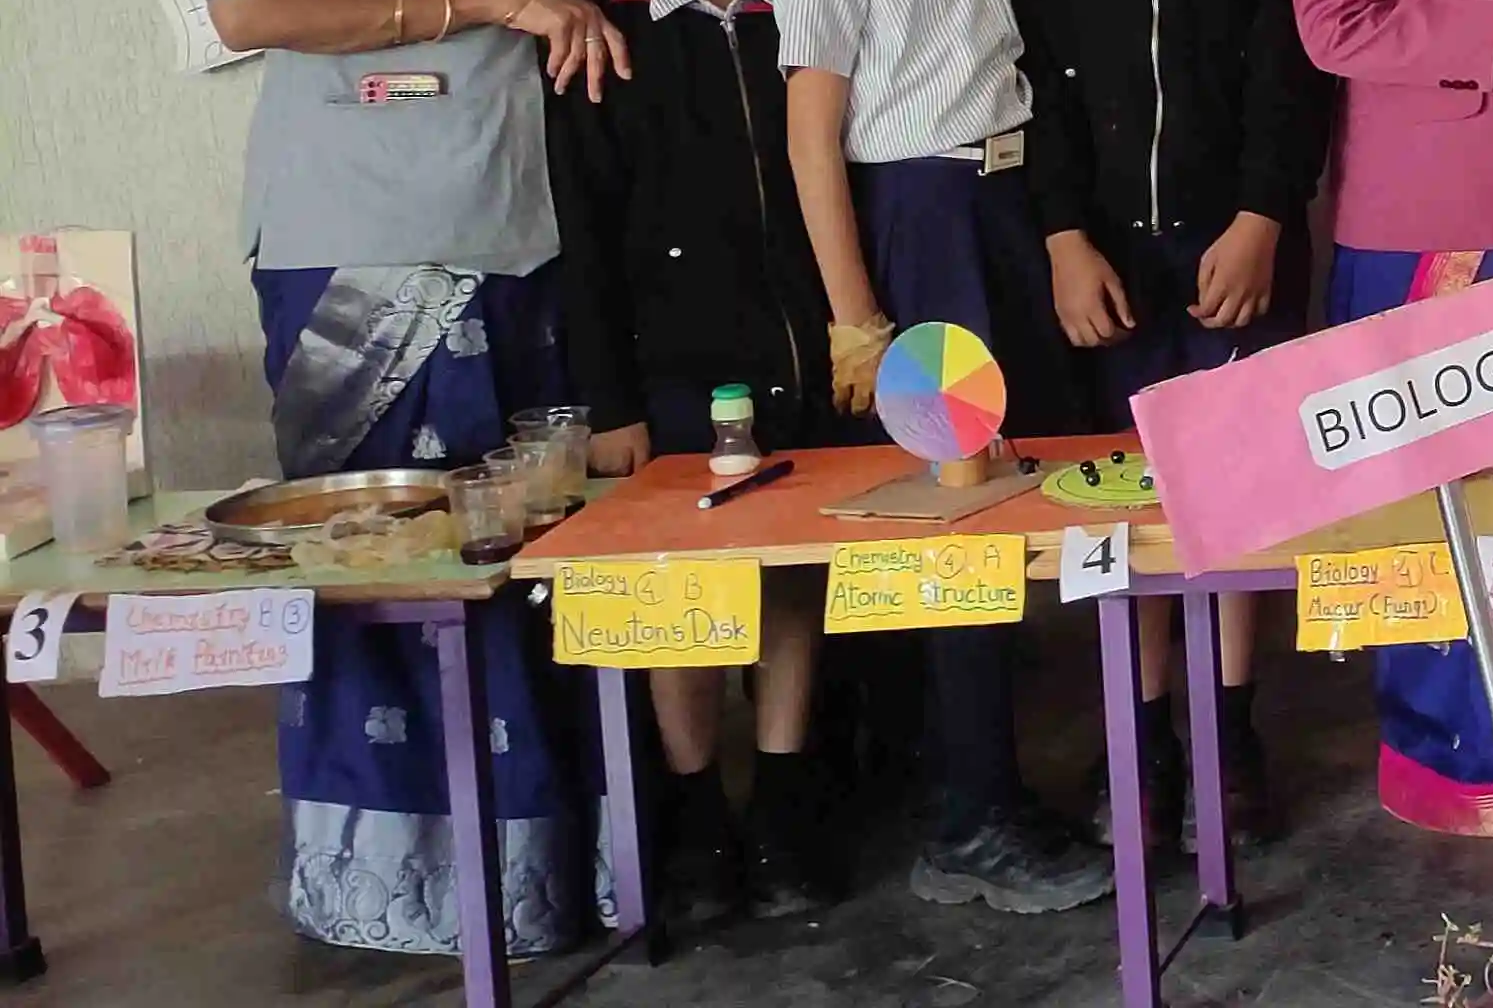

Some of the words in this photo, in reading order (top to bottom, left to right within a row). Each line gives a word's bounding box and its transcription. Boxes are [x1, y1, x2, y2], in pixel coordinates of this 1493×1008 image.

[834, 547, 923, 573] Chemistry
[983, 545, 999, 569] A
[1082, 537, 1117, 573] 4
[560, 567, 627, 596] Biology
[685, 573, 703, 599] B
[1310, 557, 1379, 584] Biology
[830, 580, 903, 608] Atomic
[921, 579, 1016, 604] Structure
[15, 608, 49, 660] 3
